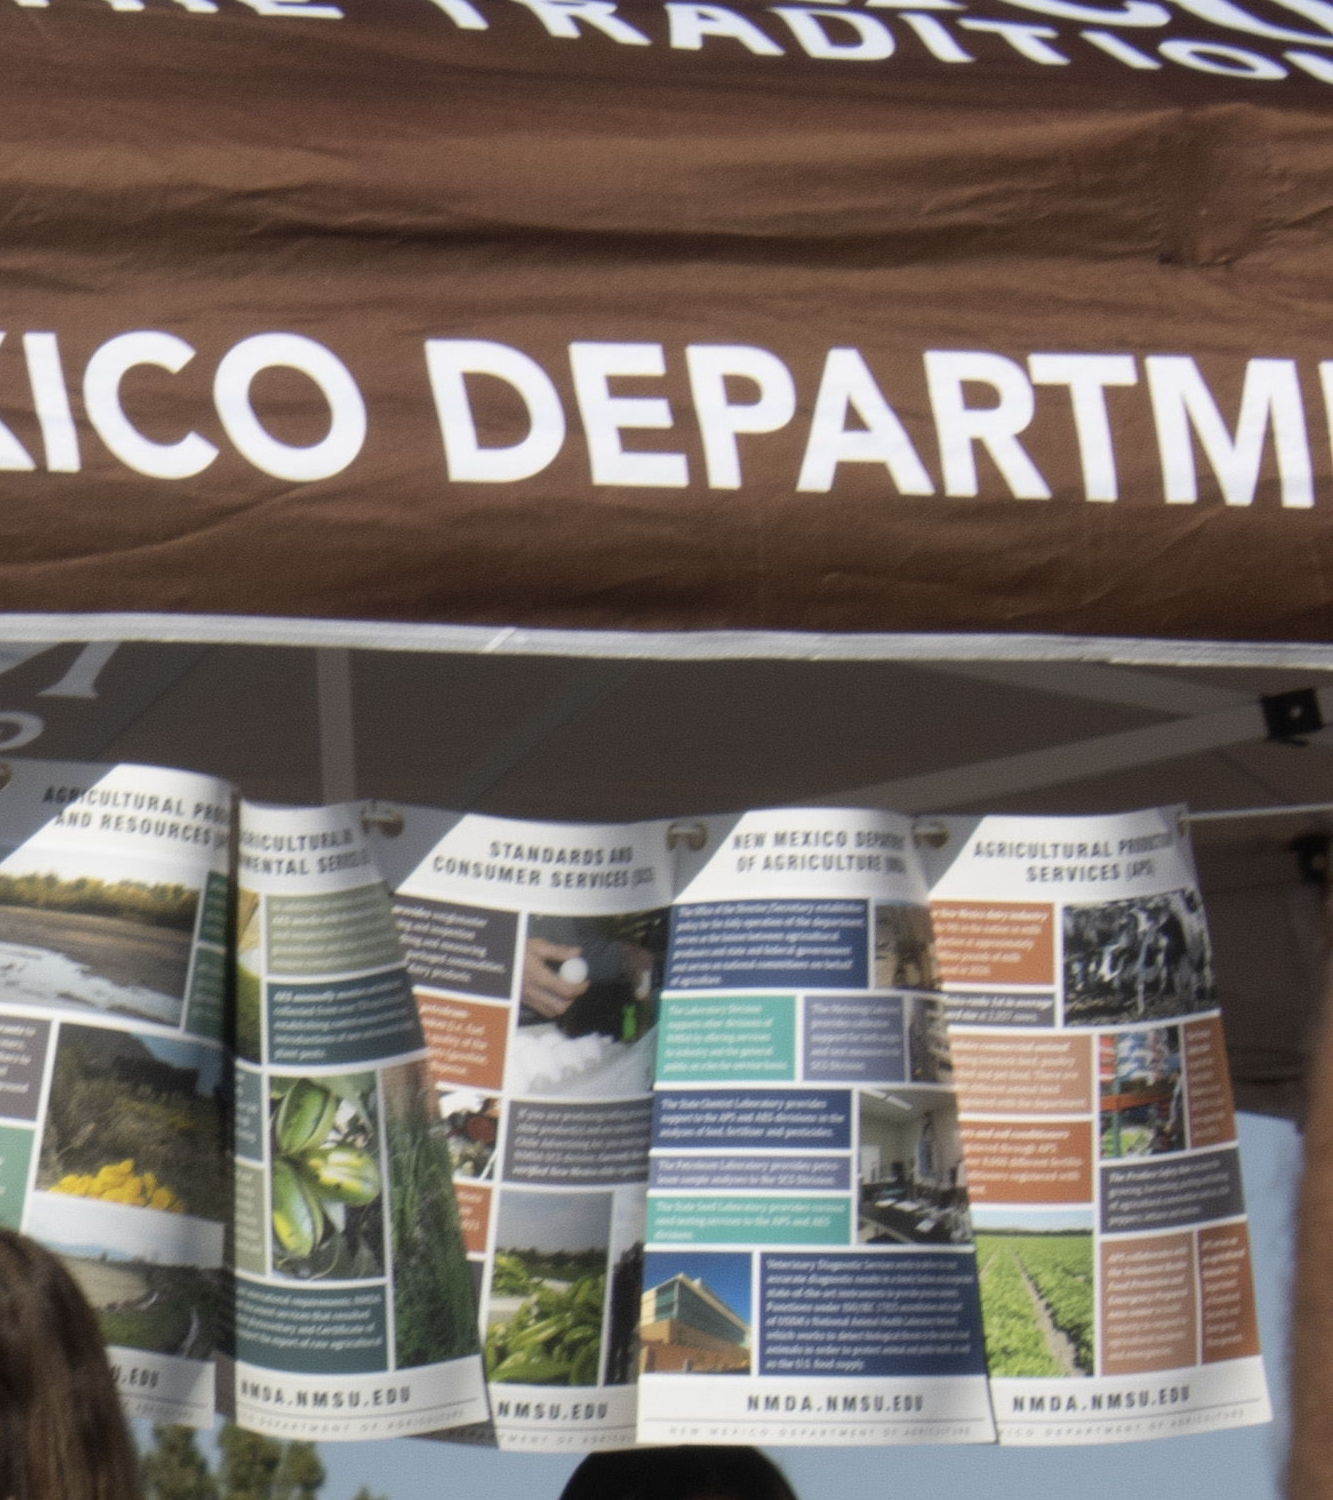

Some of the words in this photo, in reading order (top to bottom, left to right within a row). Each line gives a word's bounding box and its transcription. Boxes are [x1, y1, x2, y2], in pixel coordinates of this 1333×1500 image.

[423, 338, 1333, 510] DEPARTM
[43, 785, 185, 815] AGRICULTURAL
[55, 811, 92, 828] AND
[100, 814, 210, 845] RESOURCES
[733, 833, 767, 850] NEW
[773, 830, 848, 848] MEXICO
[489, 841, 603, 865] STANDARDS
[608, 846, 634, 863] AND
[973, 841, 1113, 858] AGRICULTURAL
[433, 856, 541, 886] CONSUMER
[550, 869, 630, 888] SERVICES
[737, 856, 759, 873] OF
[762, 854, 882, 872] AGRICULTURE
[1026, 862, 1121, 882] SERVICES
[747, 1394, 924, 1413] NMDA.NMSU.EDU
[1012, 1385, 1191, 1413] NMDA.NMSU.EDU
